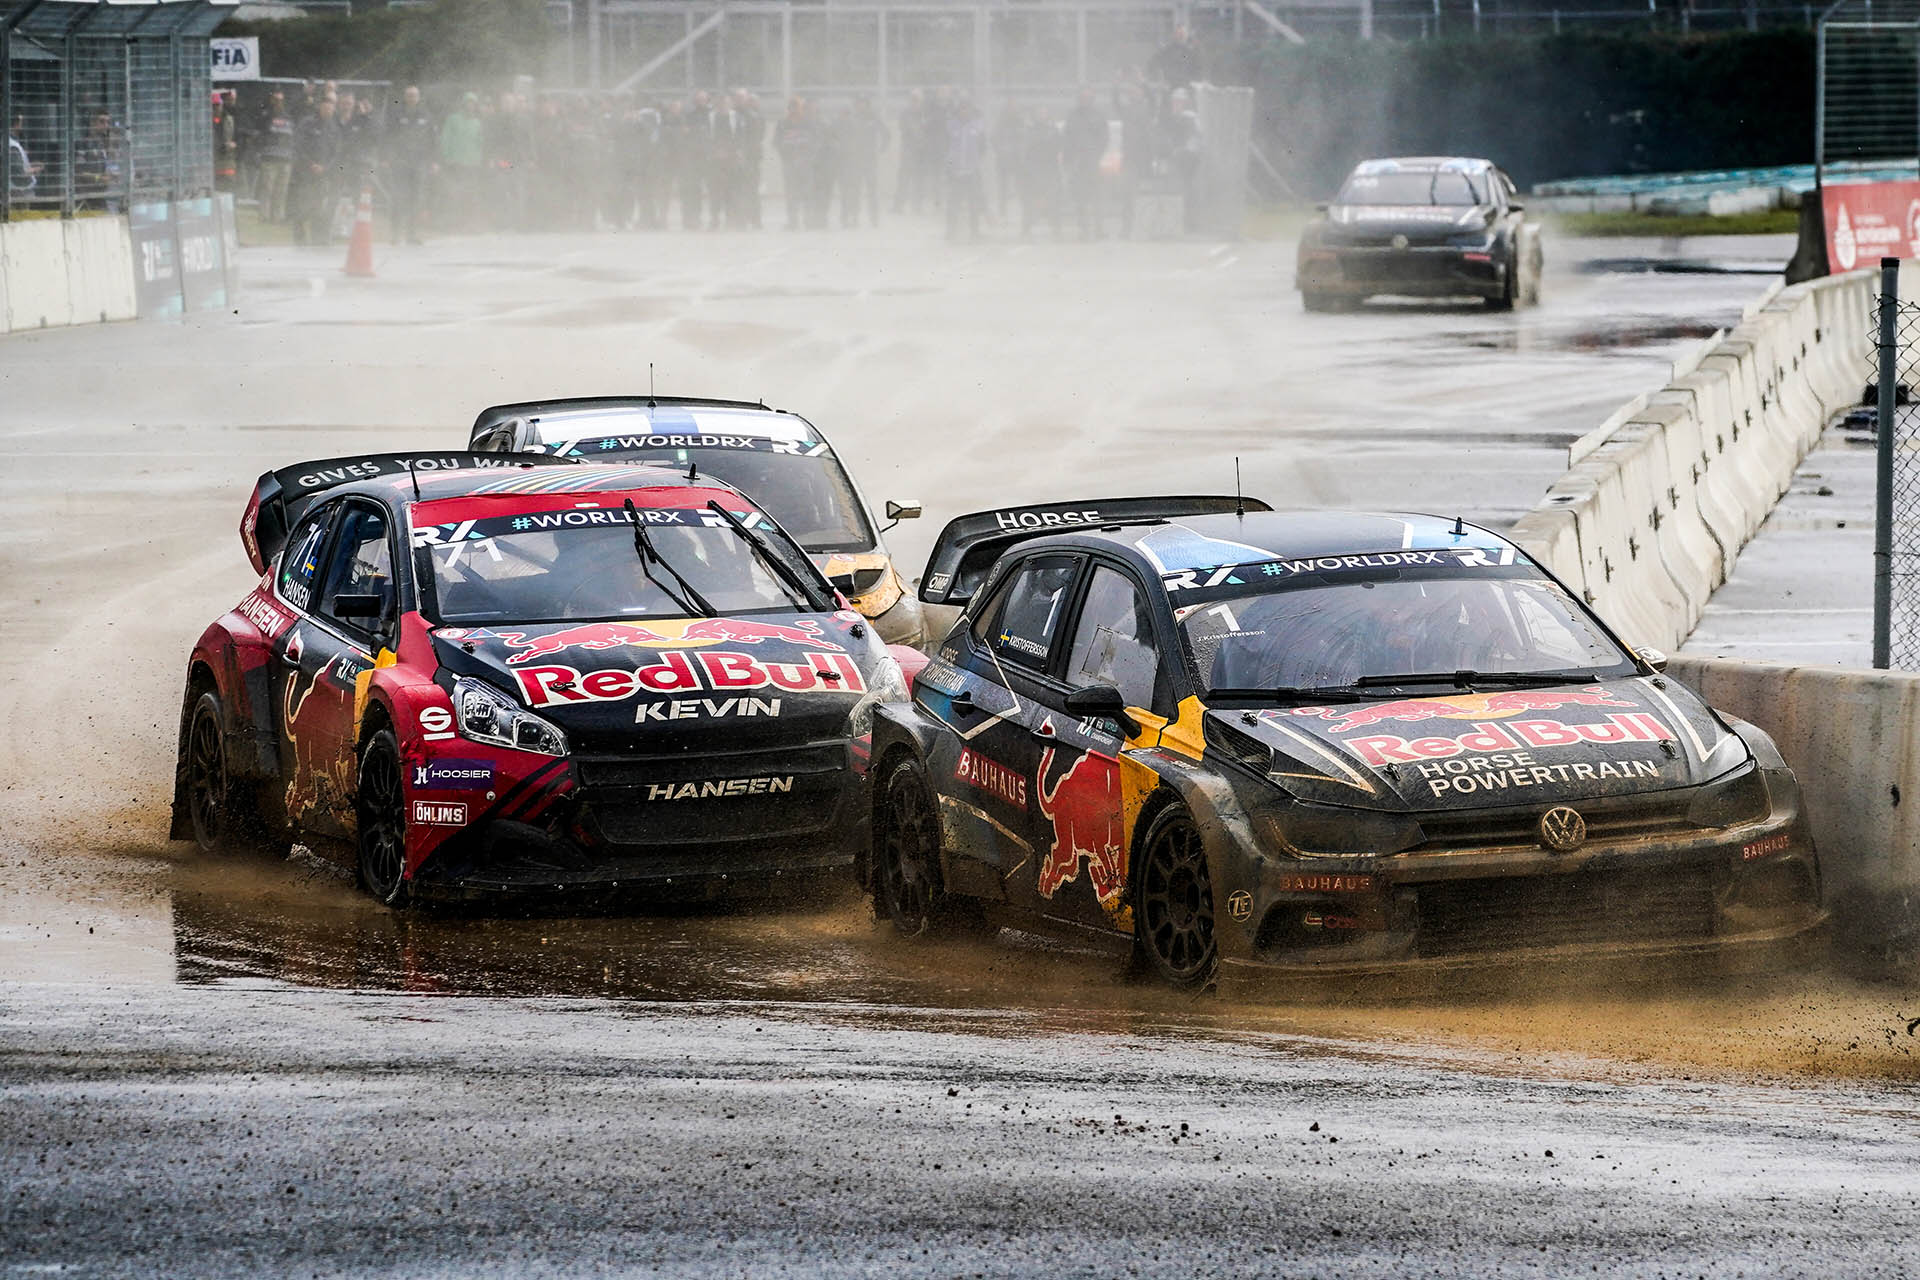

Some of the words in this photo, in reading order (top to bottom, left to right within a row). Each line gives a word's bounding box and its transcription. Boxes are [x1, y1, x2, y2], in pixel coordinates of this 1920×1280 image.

[600, 435, 754, 450] #WORLDRX
[298, 461, 381, 487] GIVES
[395, 458, 459, 471] YOU
[512, 509, 684, 529] #WORLDRX
[996, 511, 1104, 529] HORSE
[292, 523, 322, 573] 71
[433, 538, 504, 568] 71
[1161, 563, 1246, 592] RX
[1261, 551, 1446, 577] #WORLDRX
[282, 578, 311, 610] HANSEN
[927, 576, 952, 590] OMP
[1042, 586, 1064, 637] 1
[1207, 603, 1241, 632] 1
[512, 652, 702, 706] Red
[700, 651, 868, 695] Bull
[634, 698, 781, 724] KEVIN
[1345, 722, 1524, 766] Red
[1507, 713, 1679, 746] Bull
[431, 769, 491, 779] HOOSIER
[958, 751, 1027, 805] BAUHAUS
[1417, 752, 1533, 779] HORSE
[1427, 760, 1660, 798] POWERTRAIN
[648, 776, 794, 801] HANSEN
[416, 802, 465, 822] ÖHLINS
